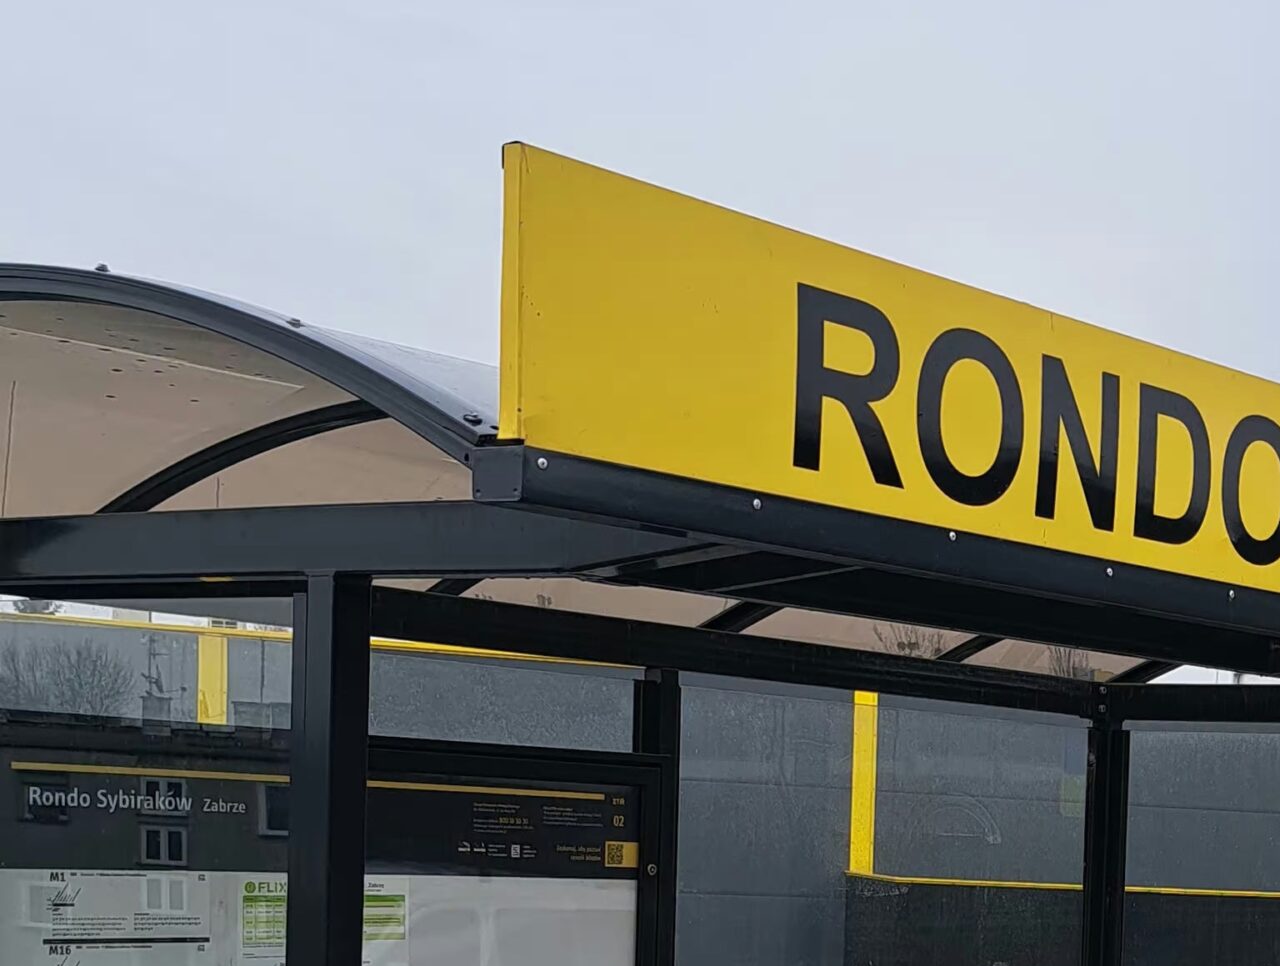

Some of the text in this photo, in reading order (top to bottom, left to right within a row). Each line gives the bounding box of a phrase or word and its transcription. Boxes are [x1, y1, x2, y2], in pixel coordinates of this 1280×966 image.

[28, 786, 247, 814] Rondo Sybiraków Zabrze
[612, 815, 625, 827] 02
[50, 872, 66, 882] M1
[48, 945, 72, 955] M16
